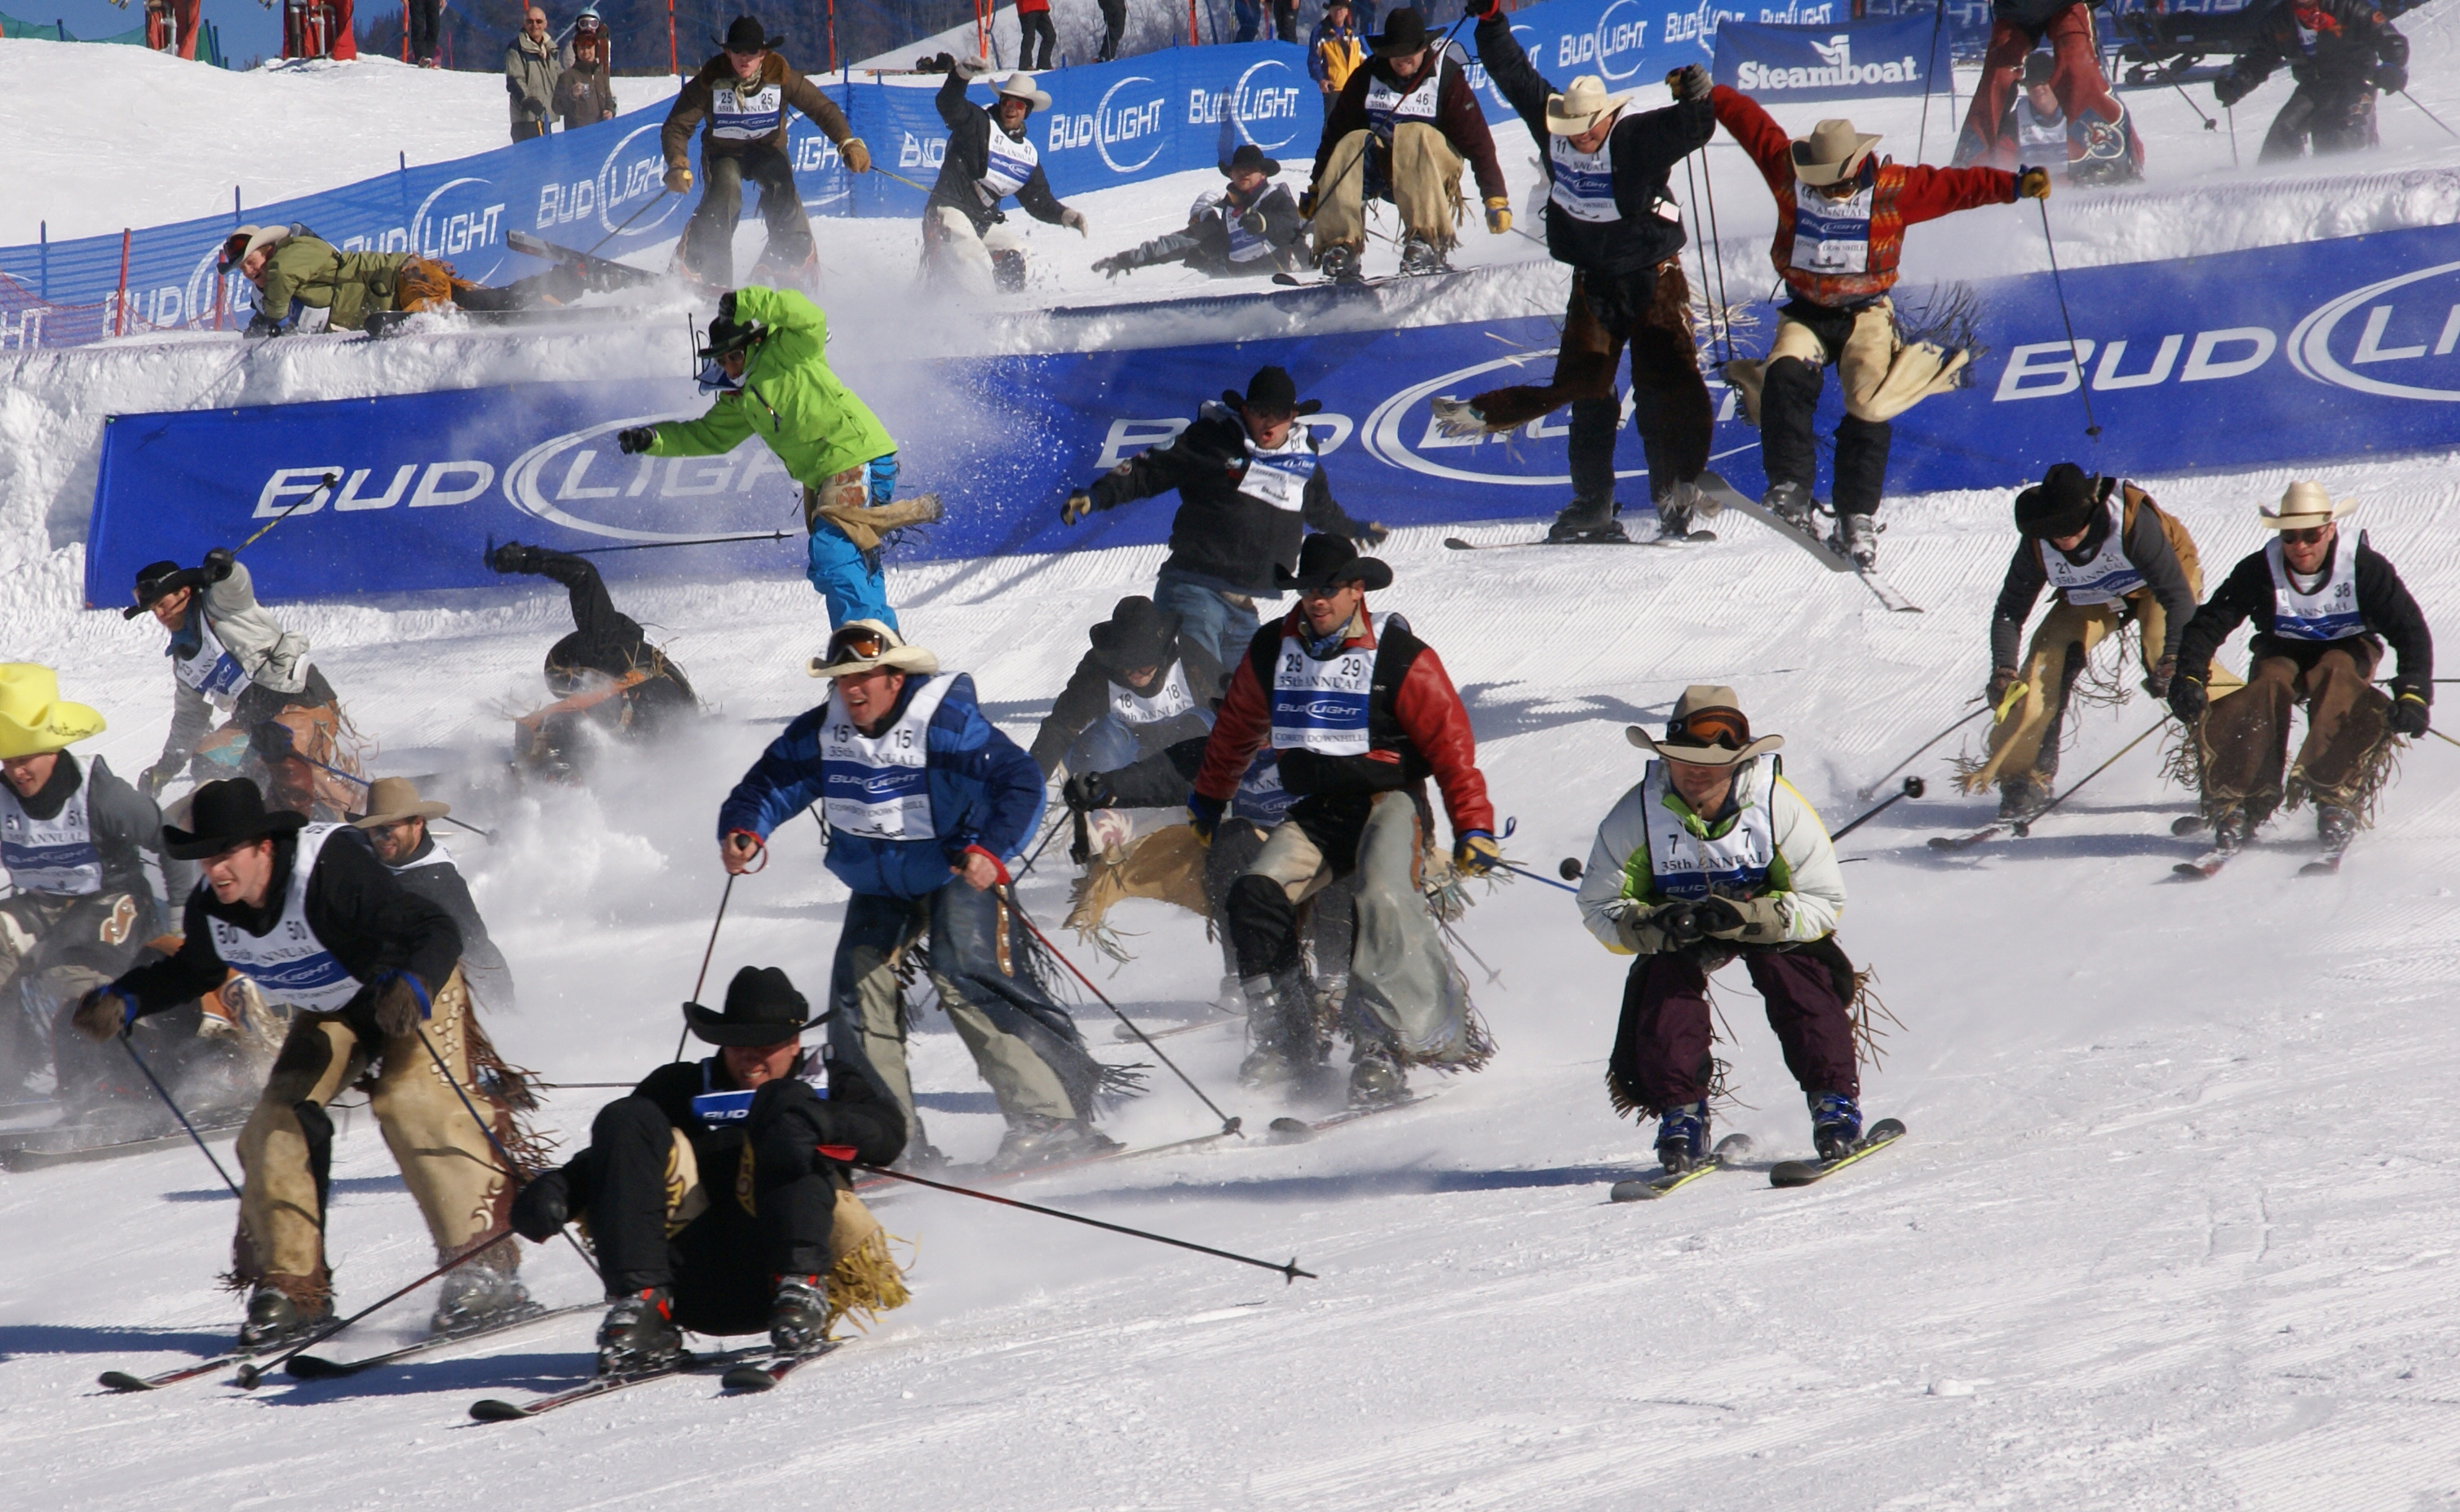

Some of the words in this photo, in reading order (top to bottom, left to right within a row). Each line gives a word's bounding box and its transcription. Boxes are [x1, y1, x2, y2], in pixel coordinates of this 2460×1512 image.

[1664, 12, 1697, 43] BUD
[1559, 33, 1595, 68] BUD
[1602, 20, 1648, 57] LIGHT
[1737, 52, 1918, 91] Steamboat
[721, 91, 732, 104] 25
[761, 93, 773, 105] 25
[1188, 89, 1232, 124] BUD
[1241, 87, 1299, 122] LIGHT
[1416, 92, 1429, 105] 46
[1048, 113, 1094, 153] BUD
[1104, 99, 1165, 144] LIGHT
[994, 135, 1004, 145] 47
[1024, 145, 1032, 155] 47
[1556, 139, 1567, 153] 11
[536, 179, 595, 229] BUD
[609, 154, 666, 208] LIGH
[1816, 206, 1862, 218] ANNUAL
[423, 203, 505, 259] LIGHT
[1993, 326, 2277, 402] BUD
[252, 460, 494, 519] BUD
[555, 449, 803, 500] LIGH
[2055, 562, 2071, 574] 21
[2101, 552, 2119, 563] 21
[2055, 577, 2077, 585] 35th
[2080, 563, 2128, 583] ANNUAL
[2334, 582, 2351, 598] 38
[2298, 603, 2350, 617] ANNUAL
[1286, 653, 1303, 673] 29
[1341, 657, 1361, 678] 29
[1305, 676, 1362, 690] ANNUAL
[1119, 692, 1133, 709] 18
[1166, 683, 1180, 701] 18
[1142, 701, 1189, 721] ANNUAL
[1310, 705, 1361, 716] LIGHT
[833, 723, 850, 743] 15
[895, 729, 912, 749] 15
[1307, 733, 1364, 742] DOWNHILL
[829, 745, 855, 758] 35th
[828, 775, 863, 785] BUD
[868, 774, 920, 789] LIGHT
[27, 832, 85, 845] ANNUAL
[1669, 833, 1679, 855] 7
[1741, 827, 1751, 849] 7
[1661, 858, 1692, 872] 35th
[1697, 851, 1766, 869] ANNUAL
[1666, 884, 1707, 894] BUD
[217, 924, 239, 944] 50
[286, 920, 308, 940] 50
[702, 1108, 750, 1120] BUD
